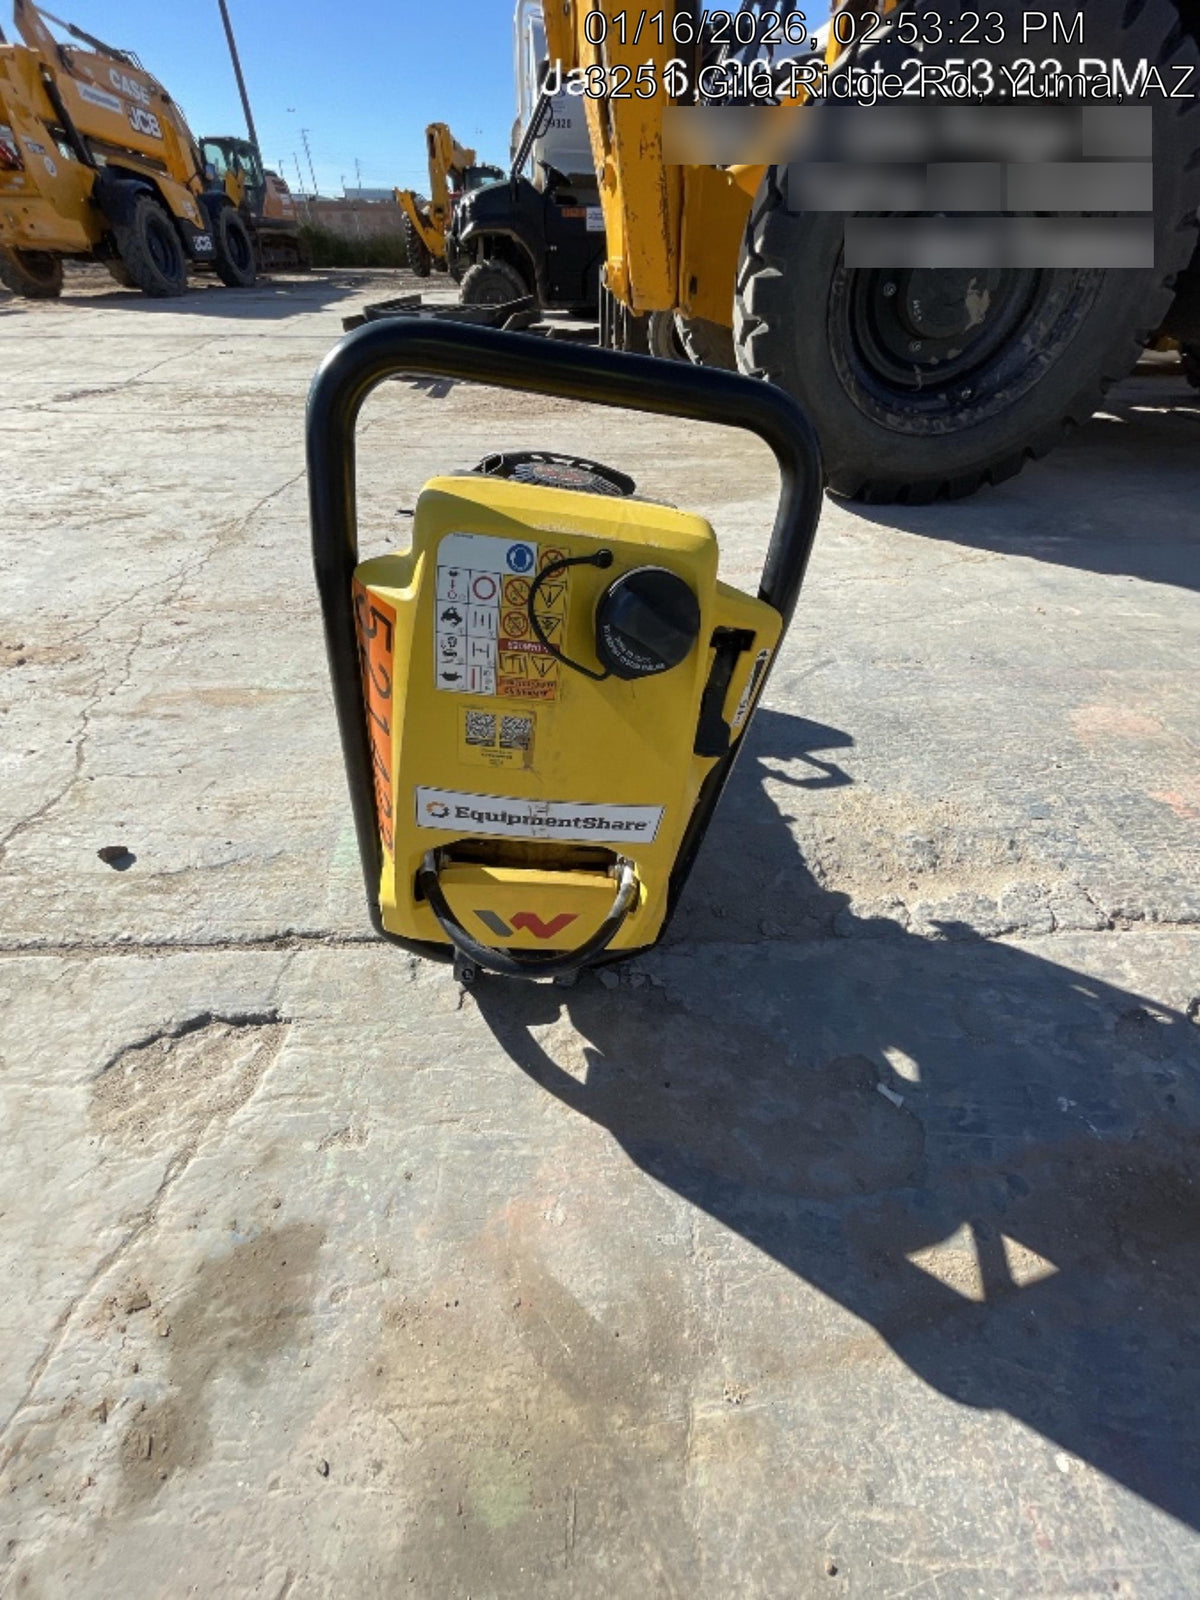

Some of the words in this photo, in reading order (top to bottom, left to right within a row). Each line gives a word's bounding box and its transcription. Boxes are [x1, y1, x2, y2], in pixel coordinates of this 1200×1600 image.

[109, 67, 151, 106] CASE
[129, 105, 162, 139] JCB
[191, 235, 213, 252] JCB
[454, 805, 648, 831] EquipmentShare
